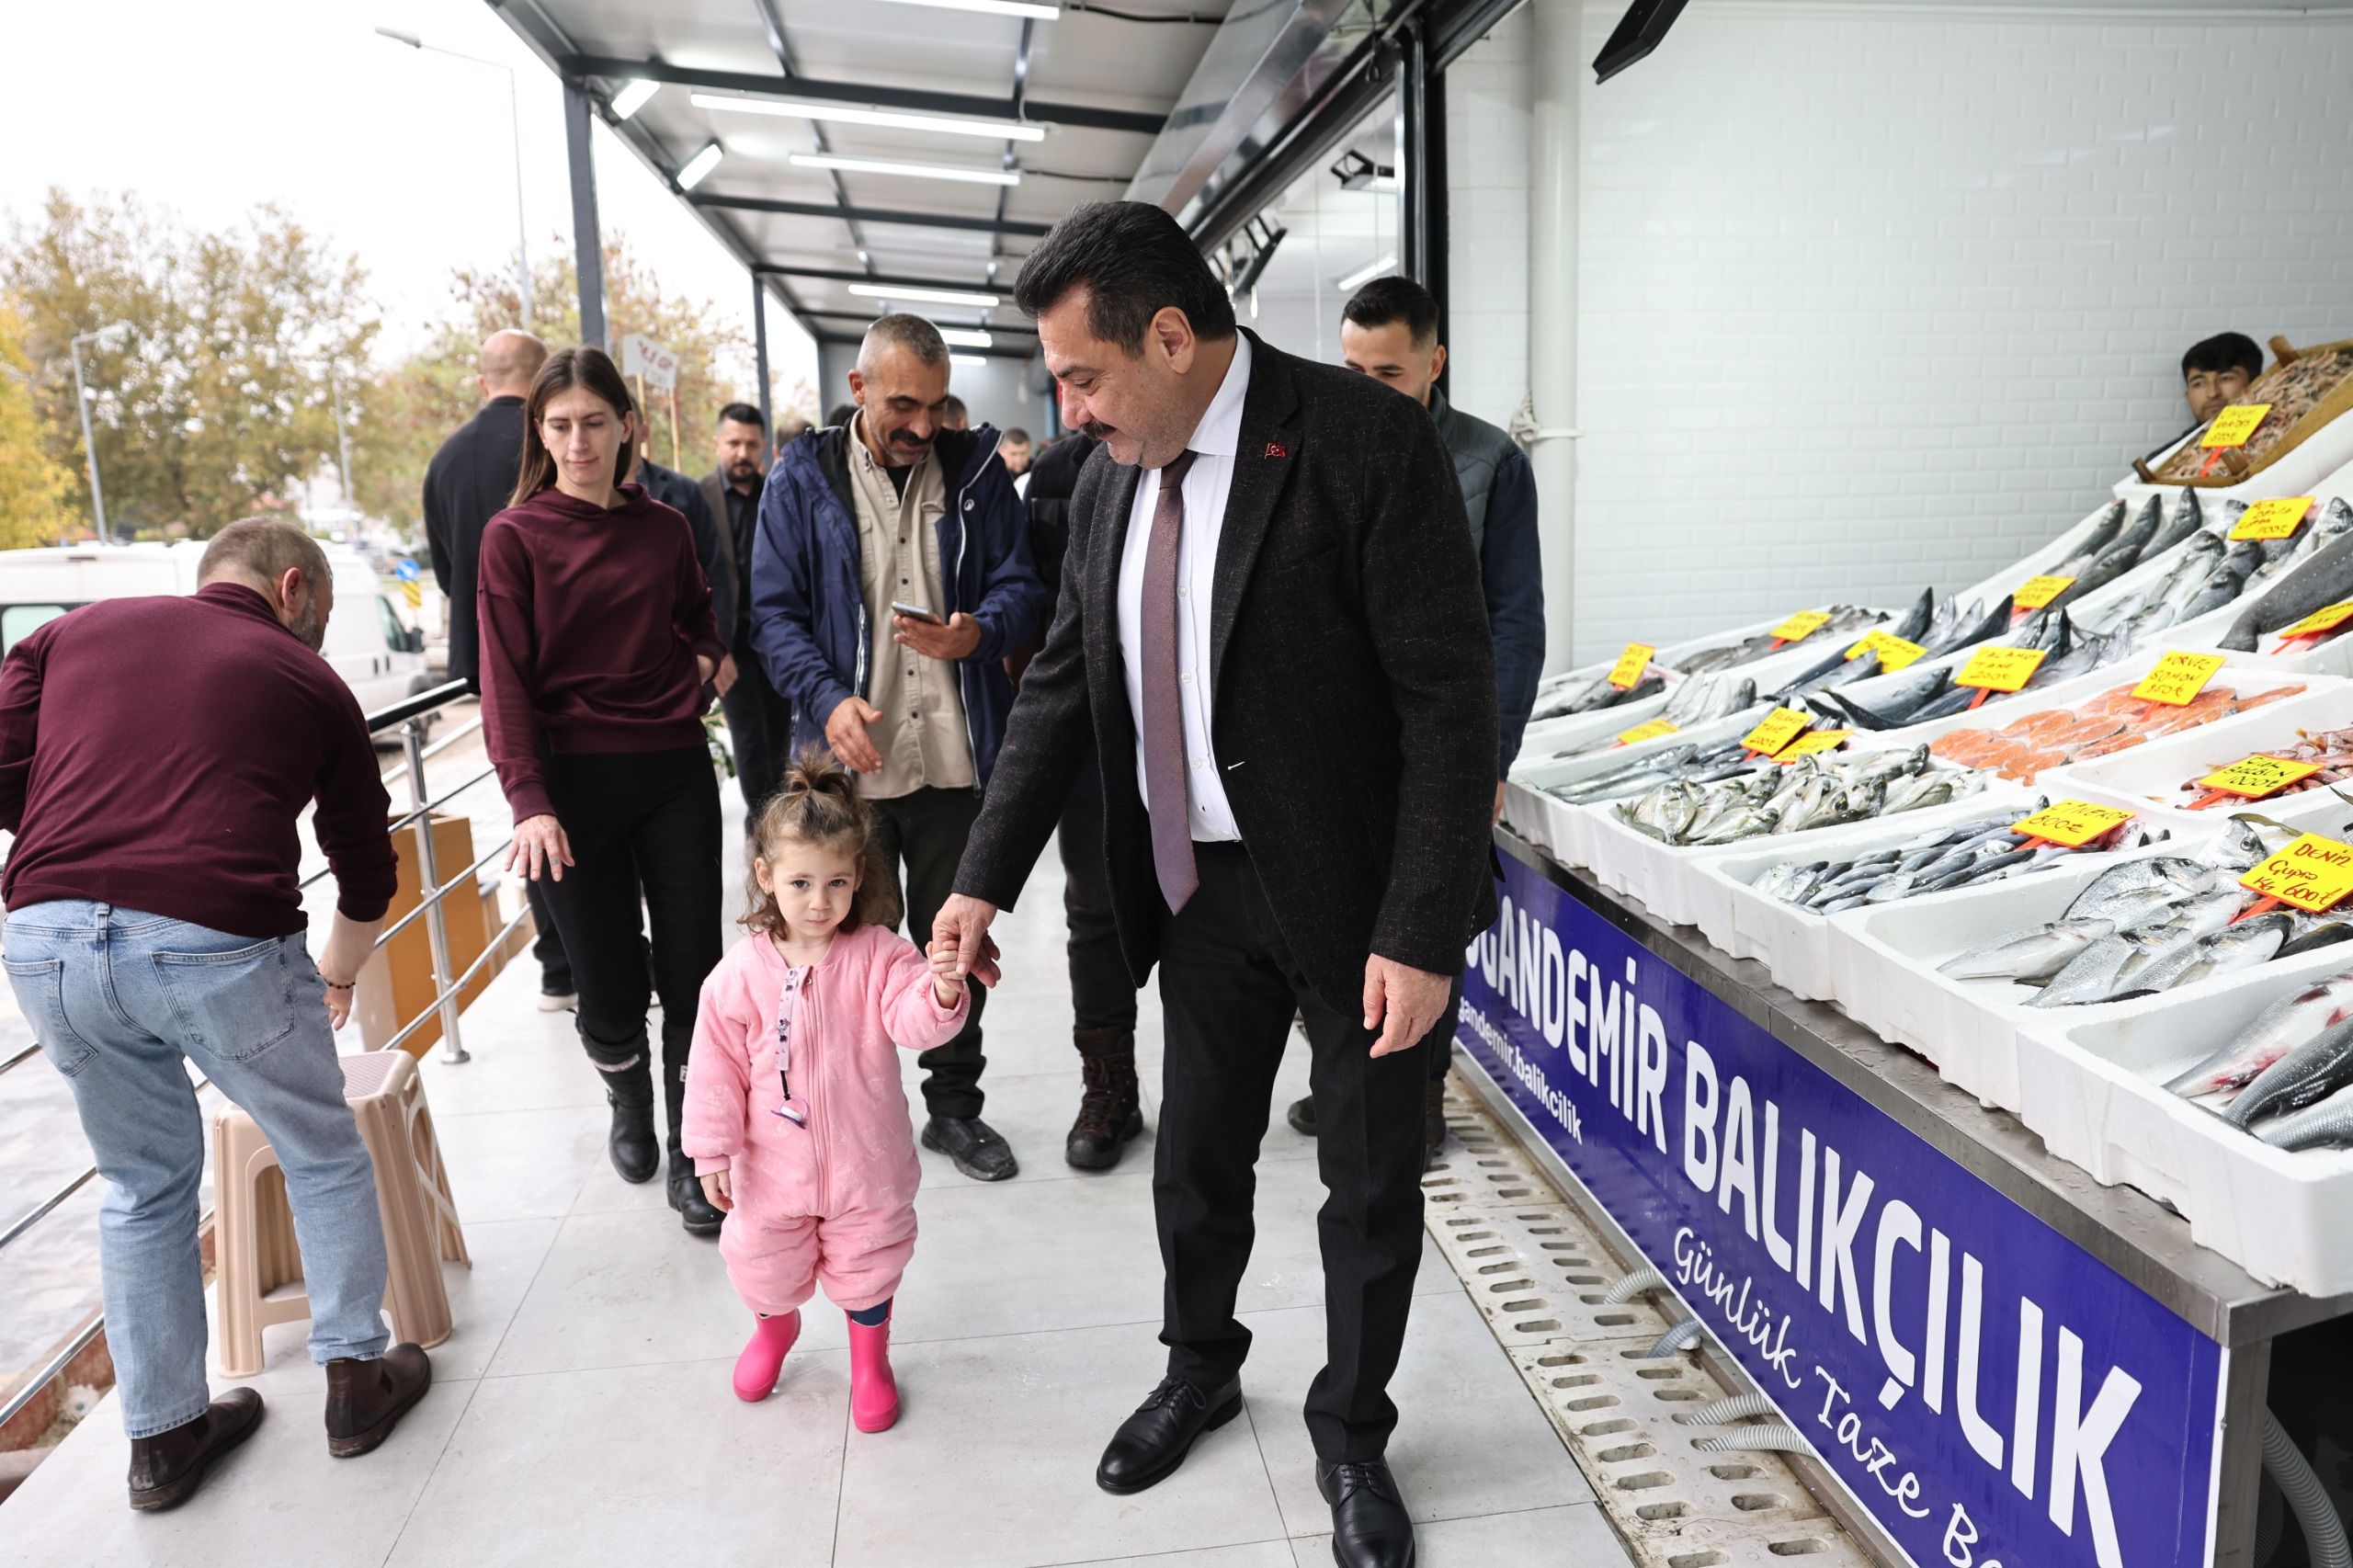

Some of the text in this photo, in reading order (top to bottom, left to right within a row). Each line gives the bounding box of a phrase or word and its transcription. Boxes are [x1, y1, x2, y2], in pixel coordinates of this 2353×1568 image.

[1674, 1227, 1802, 1390] Günlük
[1815, 1365, 1930, 1518] Taze
[1684, 1040, 2143, 1568] BALIKÇILIK
